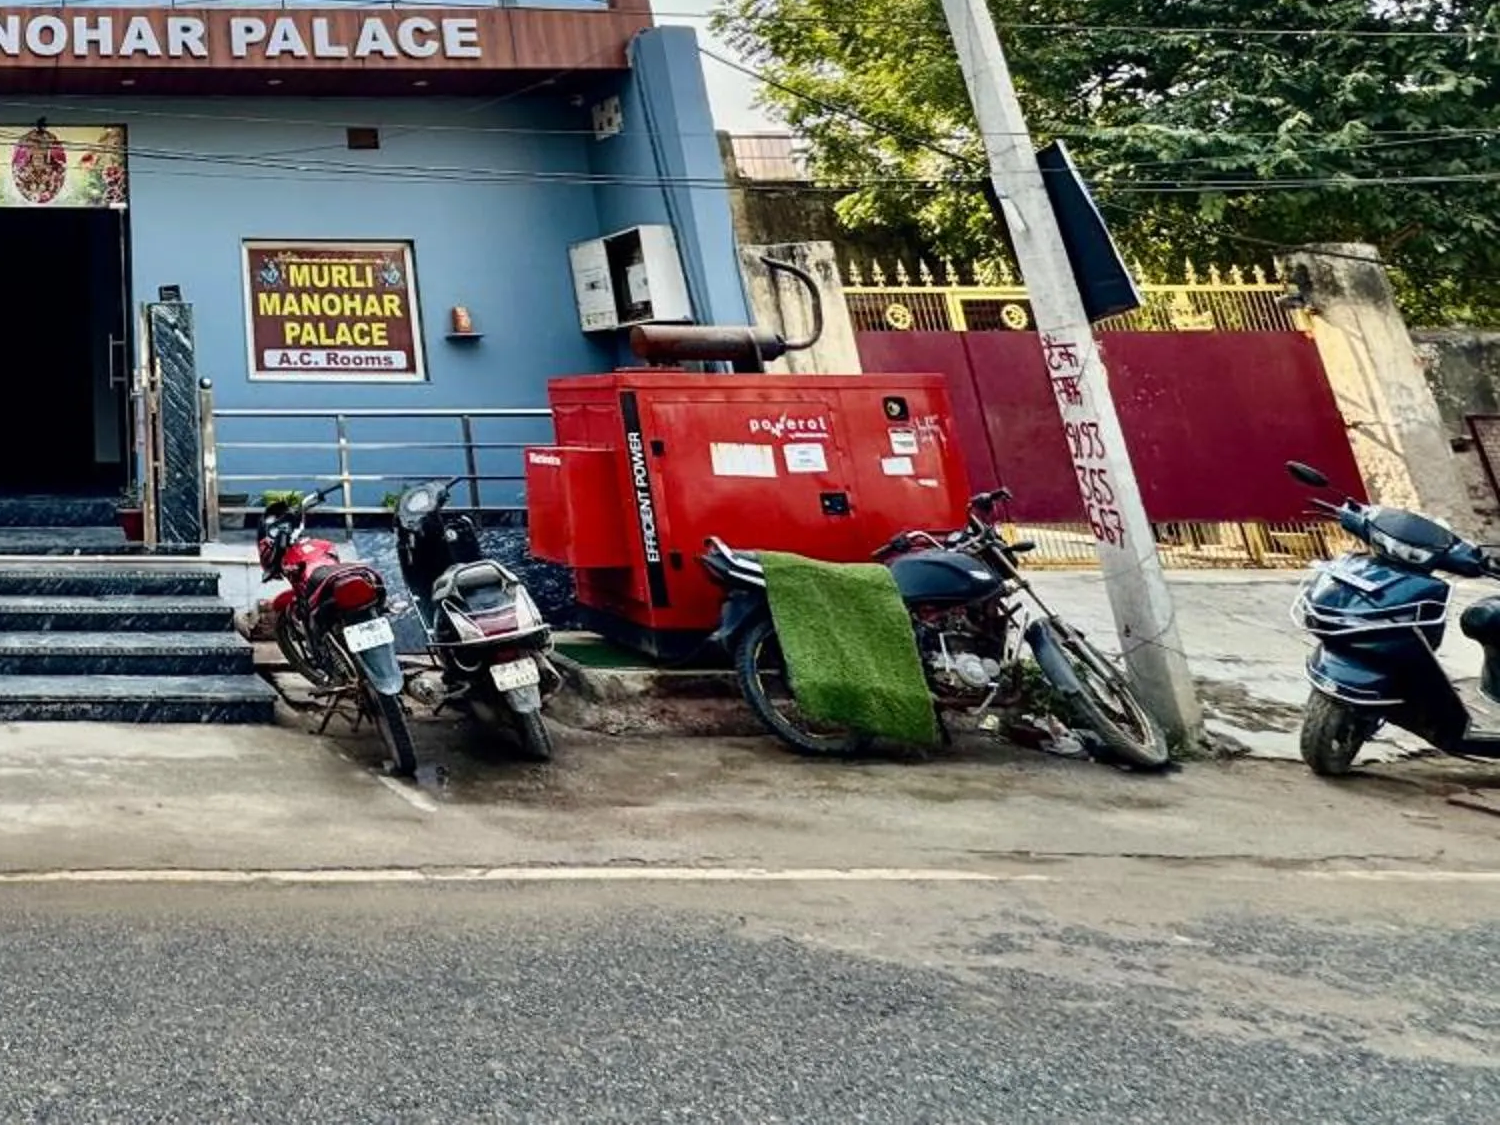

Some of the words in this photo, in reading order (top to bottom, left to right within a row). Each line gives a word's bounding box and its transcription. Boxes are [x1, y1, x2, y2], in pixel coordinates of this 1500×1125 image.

[230, 17, 482, 59] PALACE
[288, 264, 374, 288] MURLI
[258, 292, 404, 317] MANOHAR
[284, 321, 389, 346] PALACE
[278, 352, 319, 366] A.C.
[326, 352, 395, 367] Rooms
[627, 431, 649, 488] POWER
[1064, 421, 1106, 461] 9193
[1075, 464, 1116, 506] 365
[636, 490, 661, 562] EFFICIENT
